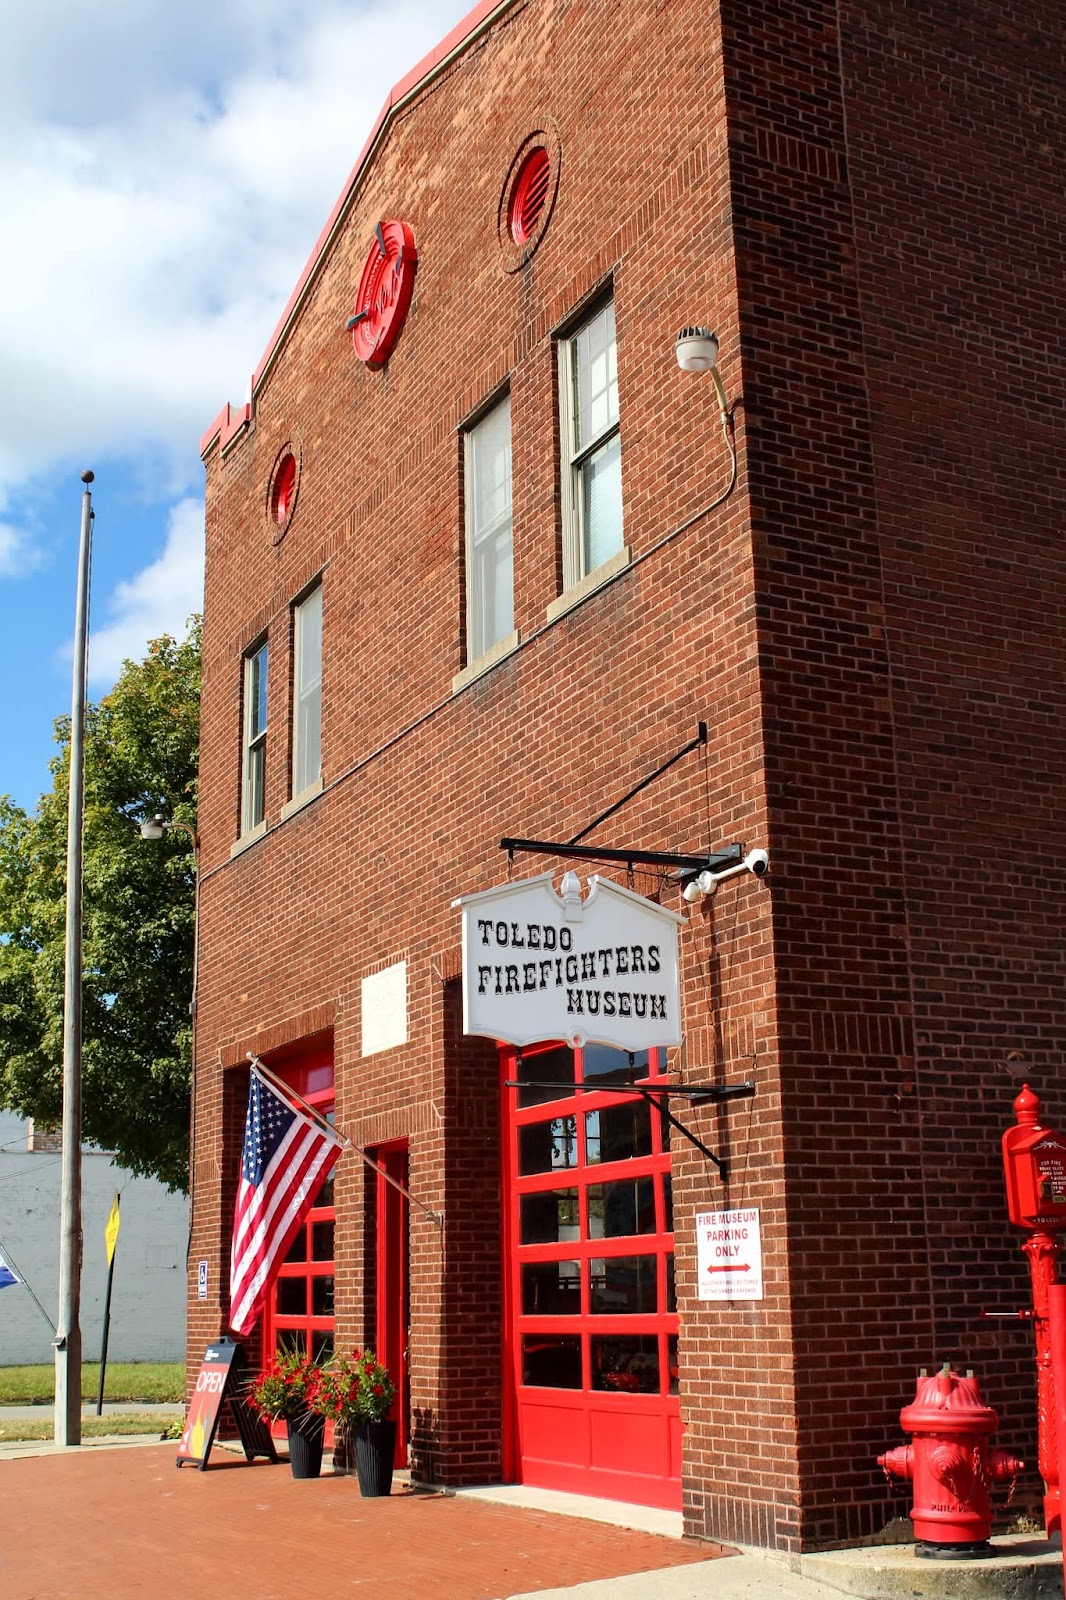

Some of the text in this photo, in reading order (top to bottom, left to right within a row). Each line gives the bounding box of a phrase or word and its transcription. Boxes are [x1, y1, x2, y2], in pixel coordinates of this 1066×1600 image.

[478, 919, 574, 953] TOLEDO
[478, 945, 661, 995] FIREFIGHTERS
[566, 988, 668, 1020] MUSEUM
[698, 1212, 756, 1226] FIRE MUSEUM
[707, 1228, 748, 1242] PARKING
[715, 1245, 740, 1258] ONLY
[196, 1371, 227, 1393] OPEN
